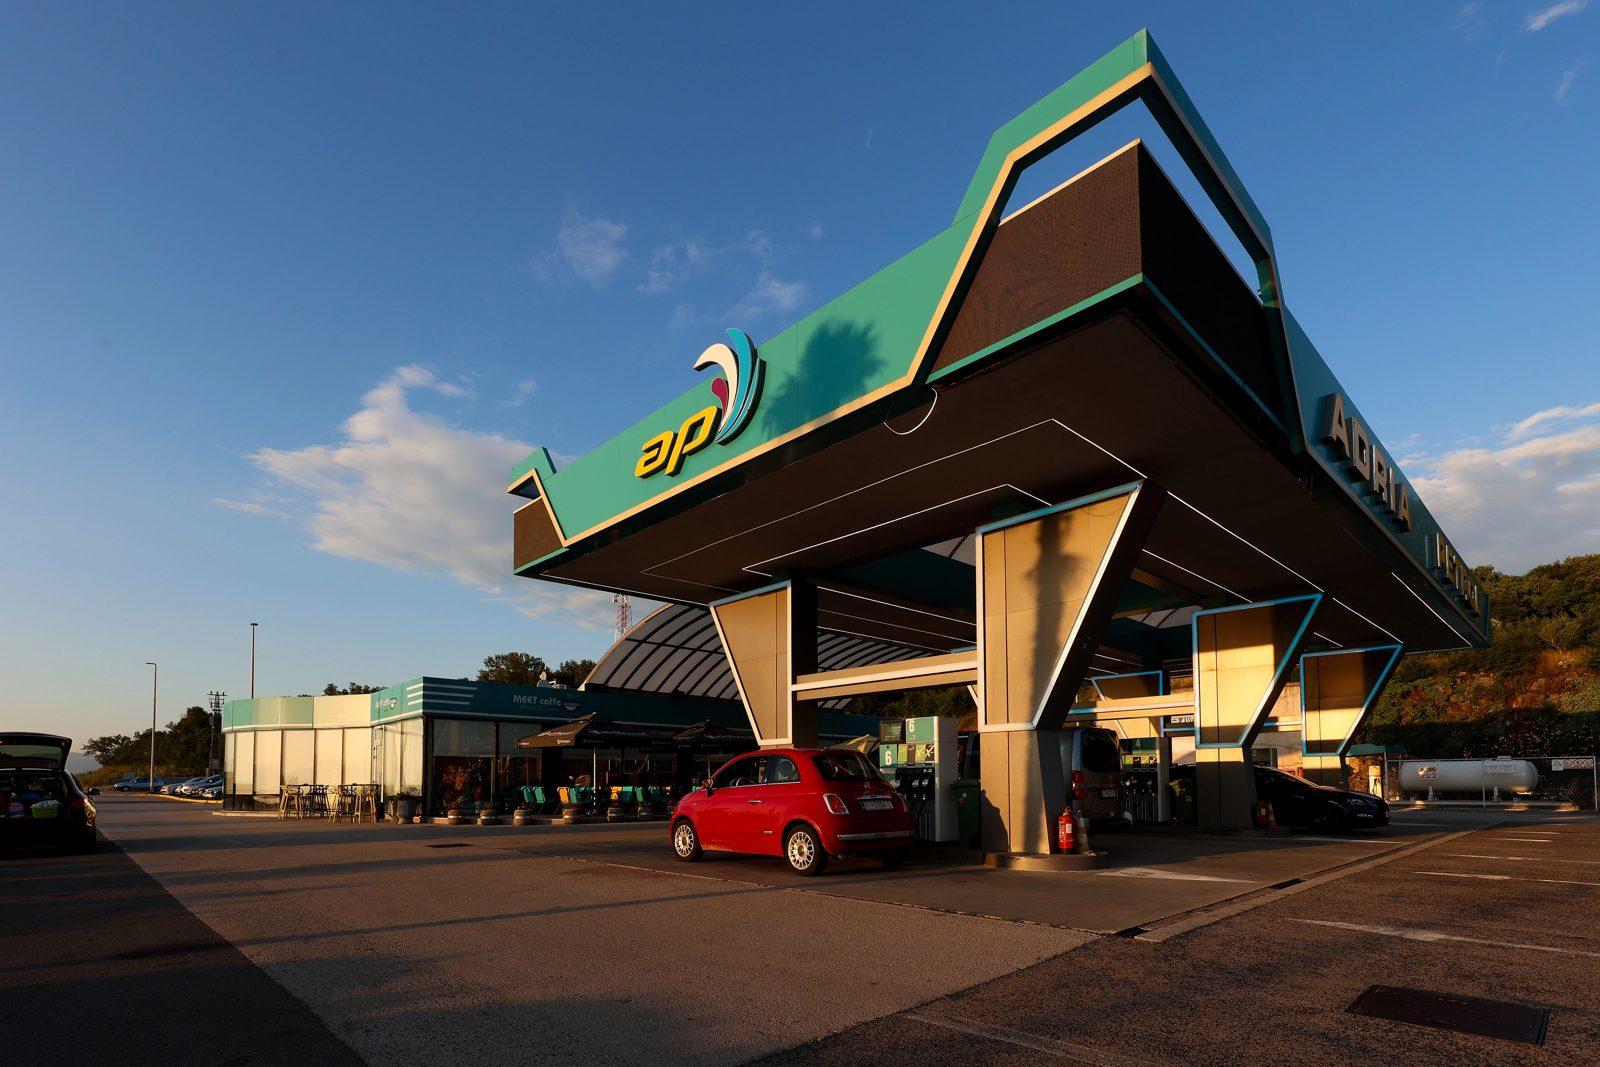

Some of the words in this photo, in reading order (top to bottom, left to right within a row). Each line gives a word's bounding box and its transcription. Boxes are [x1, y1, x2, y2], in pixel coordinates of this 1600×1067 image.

[634, 405, 719, 478] ap
[1324, 392, 1411, 532] ADRIA
[513, 694, 537, 704] MEET
[539, 697, 562, 706] caffe
[909, 720, 915, 732] 6
[885, 751, 892, 765] 6
